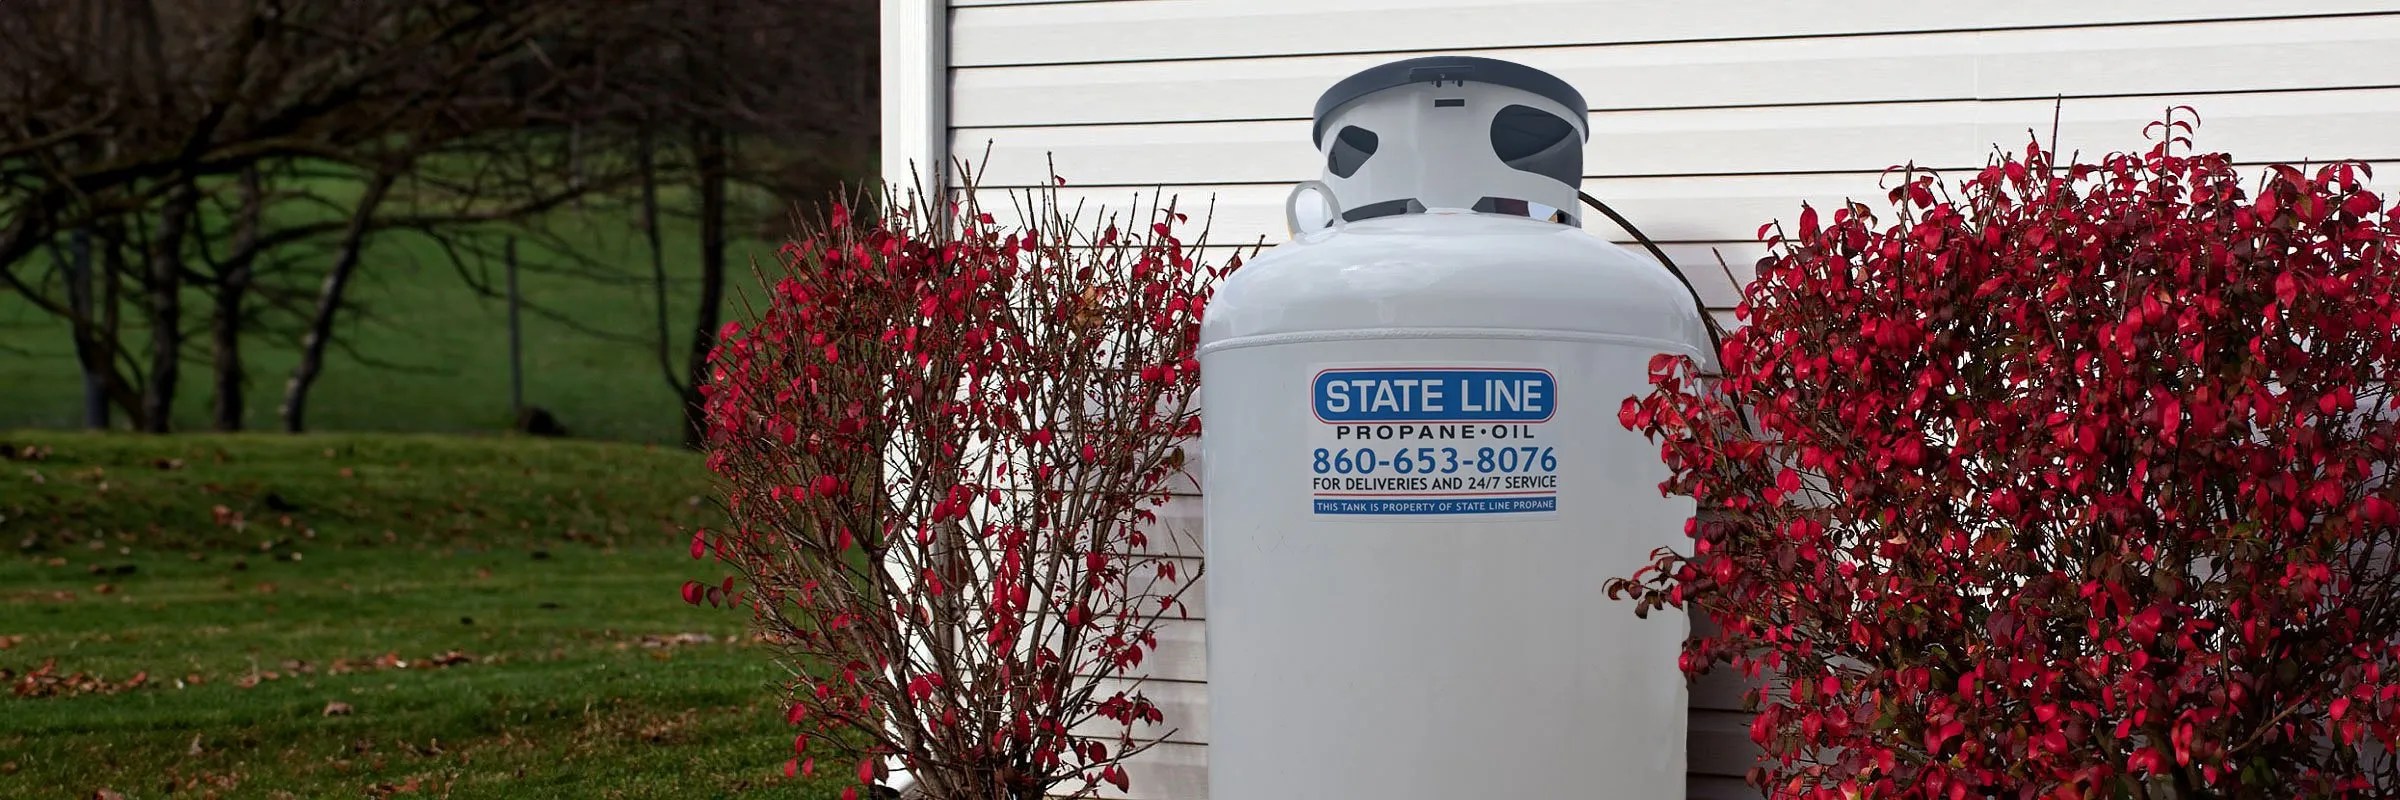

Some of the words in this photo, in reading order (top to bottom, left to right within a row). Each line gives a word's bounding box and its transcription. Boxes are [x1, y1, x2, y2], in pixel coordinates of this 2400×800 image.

[1327, 380, 1443, 412] STATE
[1462, 379, 1542, 412] LINE
[1313, 447, 1557, 474] 860-653-8076
[1313, 478, 1341, 490] FOR
[1346, 477, 1427, 490] DELIVERIES
[1432, 477, 1462, 489] AND
[1468, 477, 1500, 489] 24/7
[1505, 476, 1556, 488] SERVICE
[1318, 503, 1338, 511] THIS
[1342, 503, 1366, 511] TANK
[1371, 503, 1380, 511] IS
[1383, 503, 1435, 511] PROPERTY
[1439, 502, 1452, 511] OF
[1456, 502, 1485, 510] STATE
[1489, 501, 1509, 510] LINE
[1513, 500, 1554, 509] PROPANE
